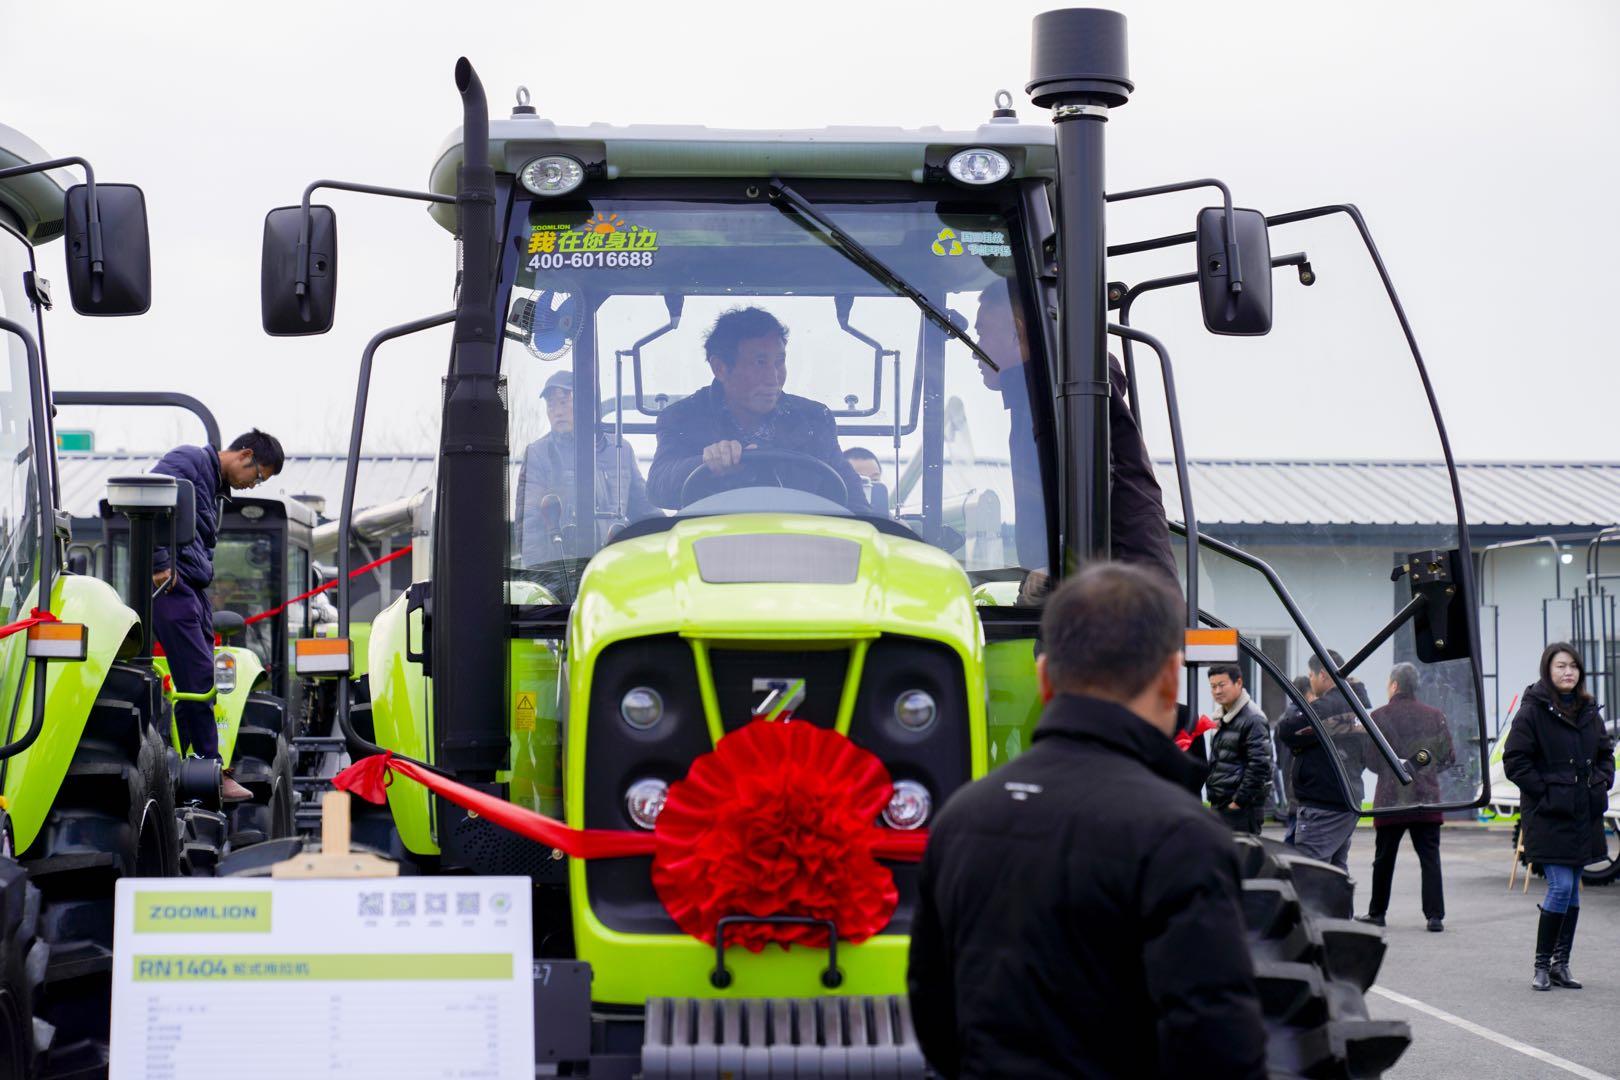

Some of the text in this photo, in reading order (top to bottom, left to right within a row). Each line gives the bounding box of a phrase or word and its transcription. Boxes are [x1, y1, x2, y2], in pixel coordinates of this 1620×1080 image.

[528, 226, 659, 253] 我在你身边
[528, 251, 654, 269] 400-6016688
[149, 905, 258, 920] ZOOMLION
[138, 959, 228, 977] RN1404
